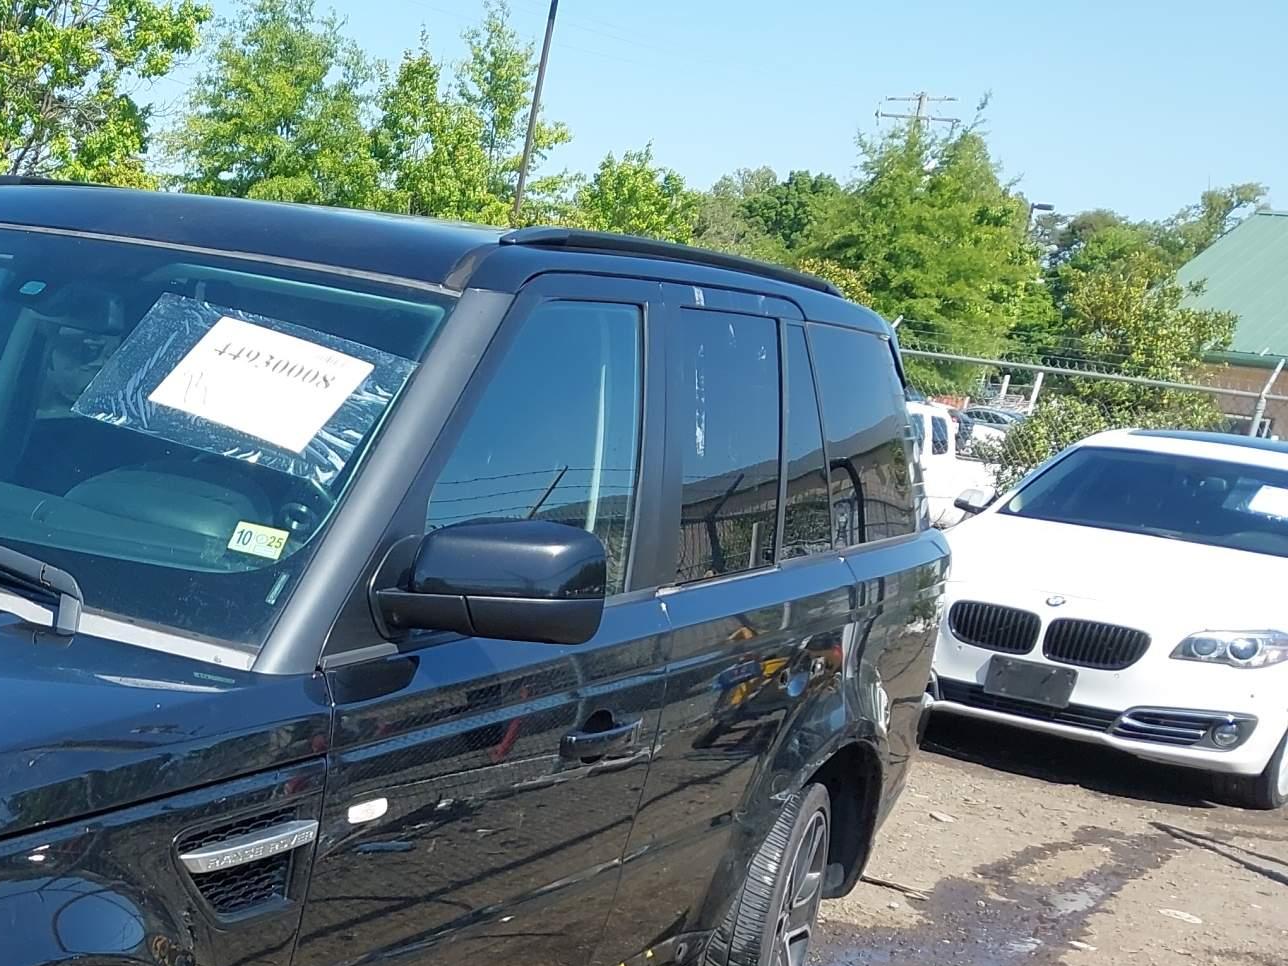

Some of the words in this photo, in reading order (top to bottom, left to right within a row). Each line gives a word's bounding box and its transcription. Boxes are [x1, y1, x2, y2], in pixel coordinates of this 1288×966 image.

[213, 341, 336, 390] 44930008
[237, 528, 253, 546] 10
[266, 535, 284, 549] 25
